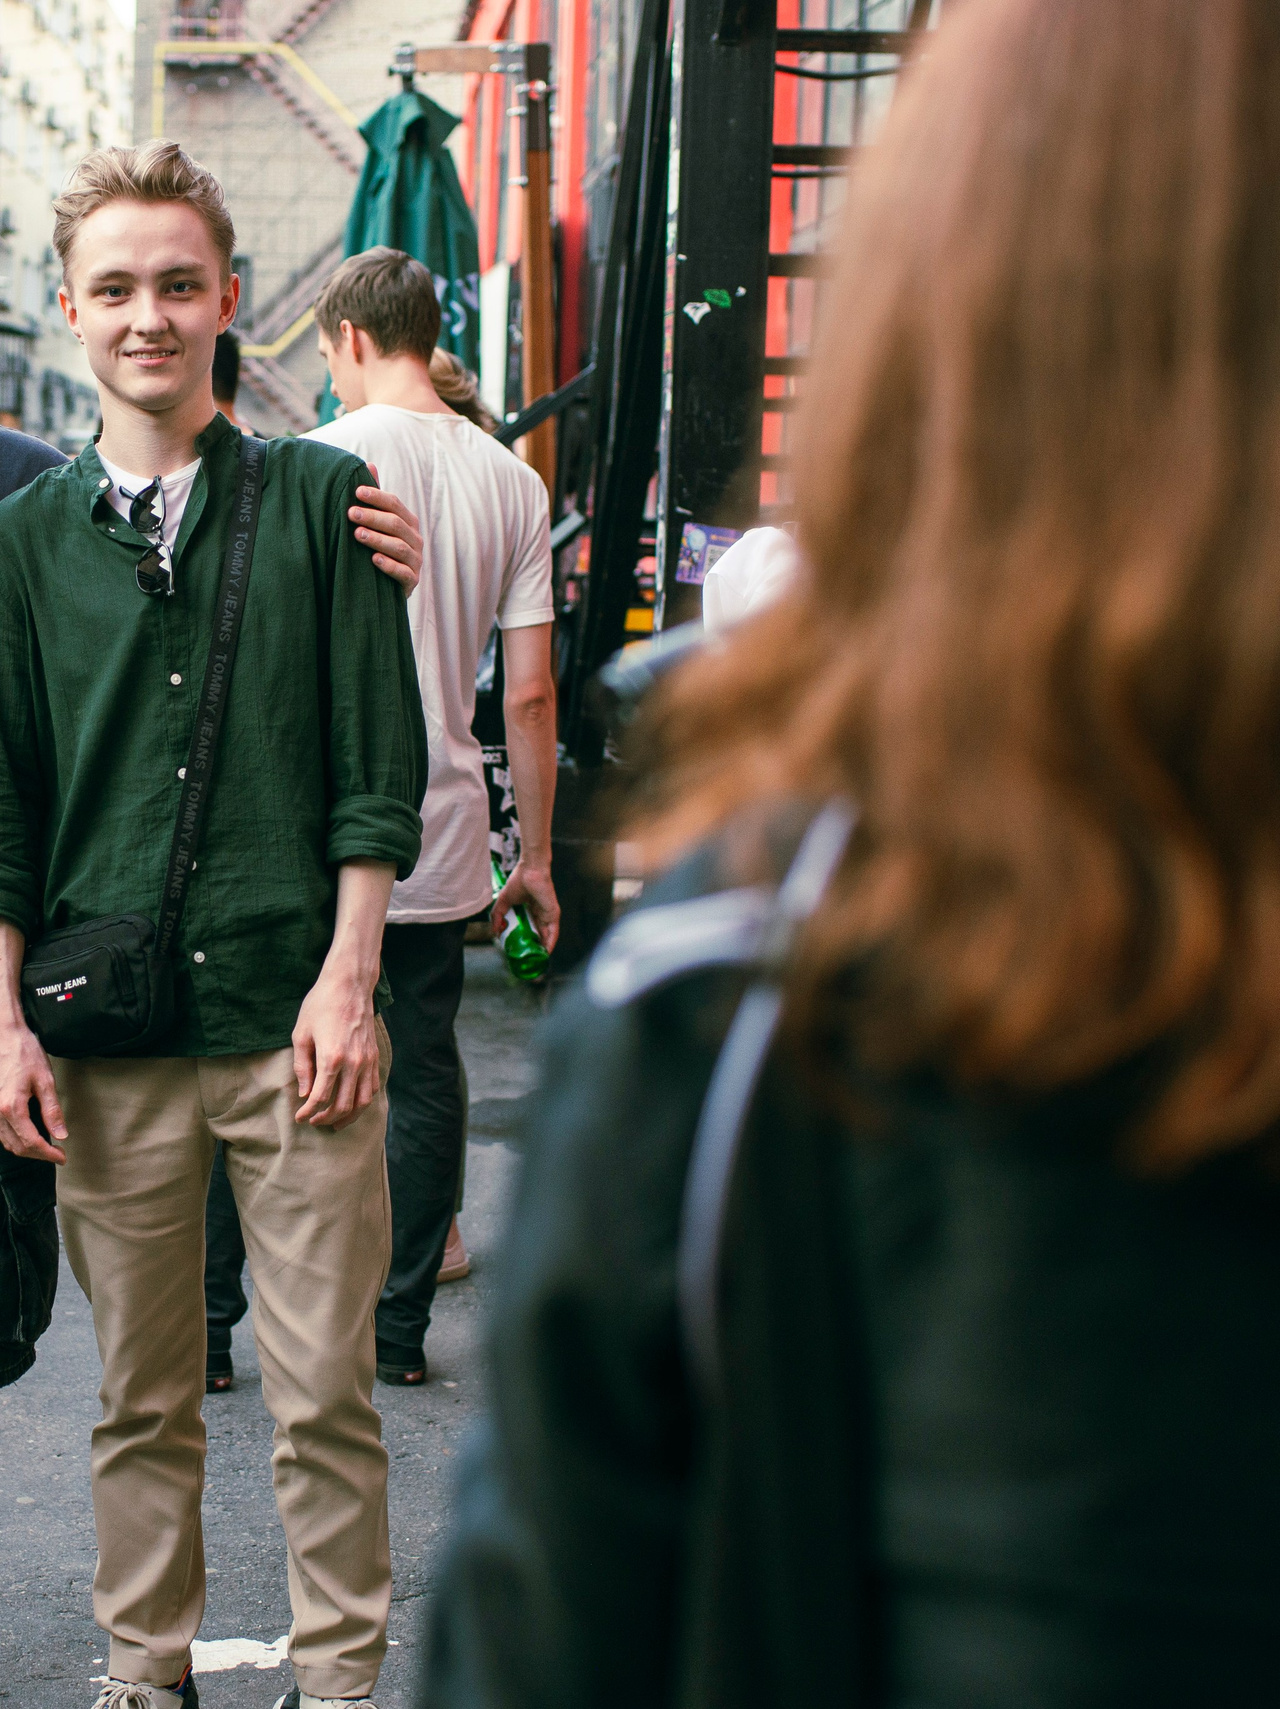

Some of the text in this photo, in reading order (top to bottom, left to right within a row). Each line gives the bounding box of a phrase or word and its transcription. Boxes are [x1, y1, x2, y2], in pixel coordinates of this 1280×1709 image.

[239, 479, 255, 523] JEANS
[228, 532, 249, 588] TOMMY
[219, 591, 238, 643] JEANS
[205, 653, 227, 715] TOMMY
[194, 717, 214, 770] JEANS
[179, 781, 203, 843] TOMMY
[169, 845, 189, 899] JEANS
[36, 976, 87, 997] TOMMY JEANS
